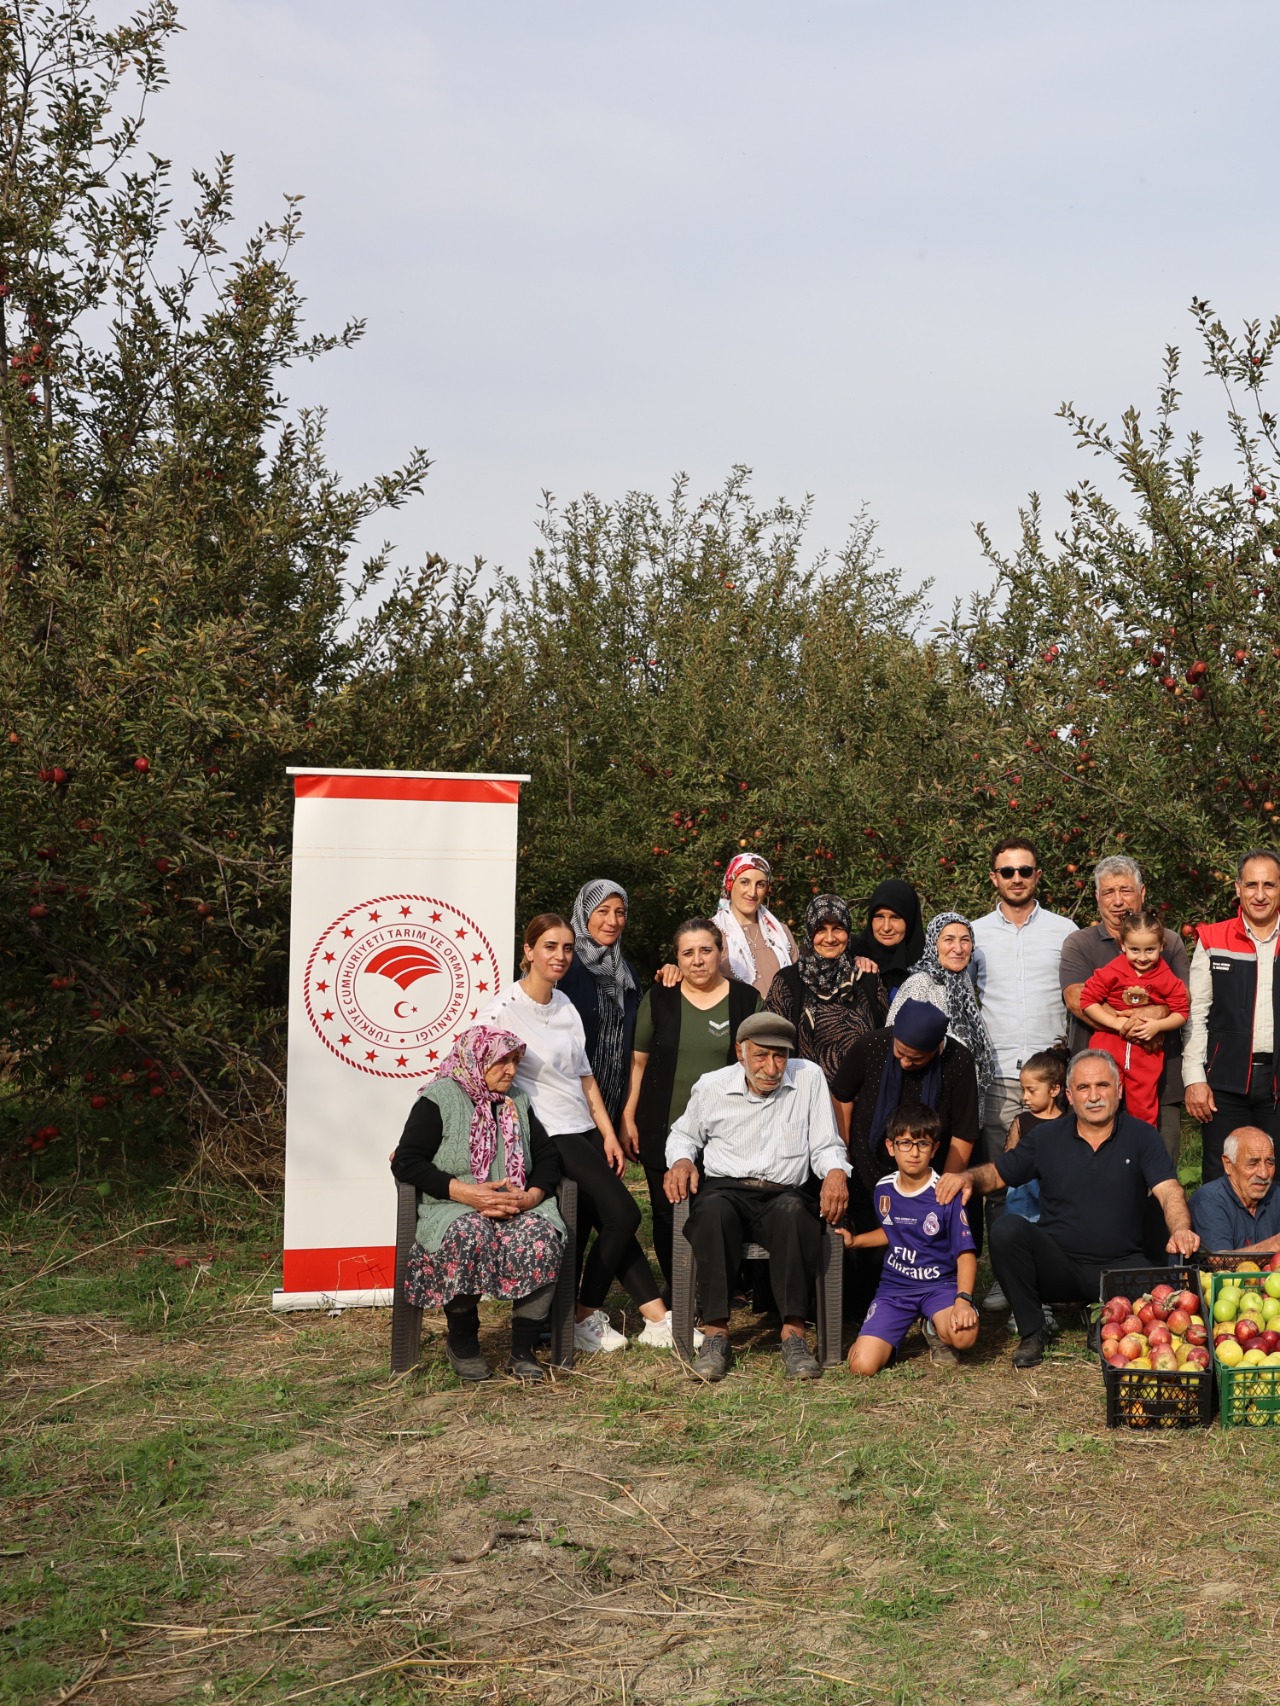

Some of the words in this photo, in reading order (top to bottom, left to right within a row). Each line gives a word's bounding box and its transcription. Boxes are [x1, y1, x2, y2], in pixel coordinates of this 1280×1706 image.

[387, 928, 427, 940] TARIM
[430, 935, 445, 949] VE
[341, 931, 385, 1005] CUMHURİYETİ
[443, 948, 465, 989] ORMAN
[347, 1007, 390, 1043] TÜRKİYE
[415, 992, 464, 1042] BAKANLIĞI
[894, 1246, 917, 1264] Fly
